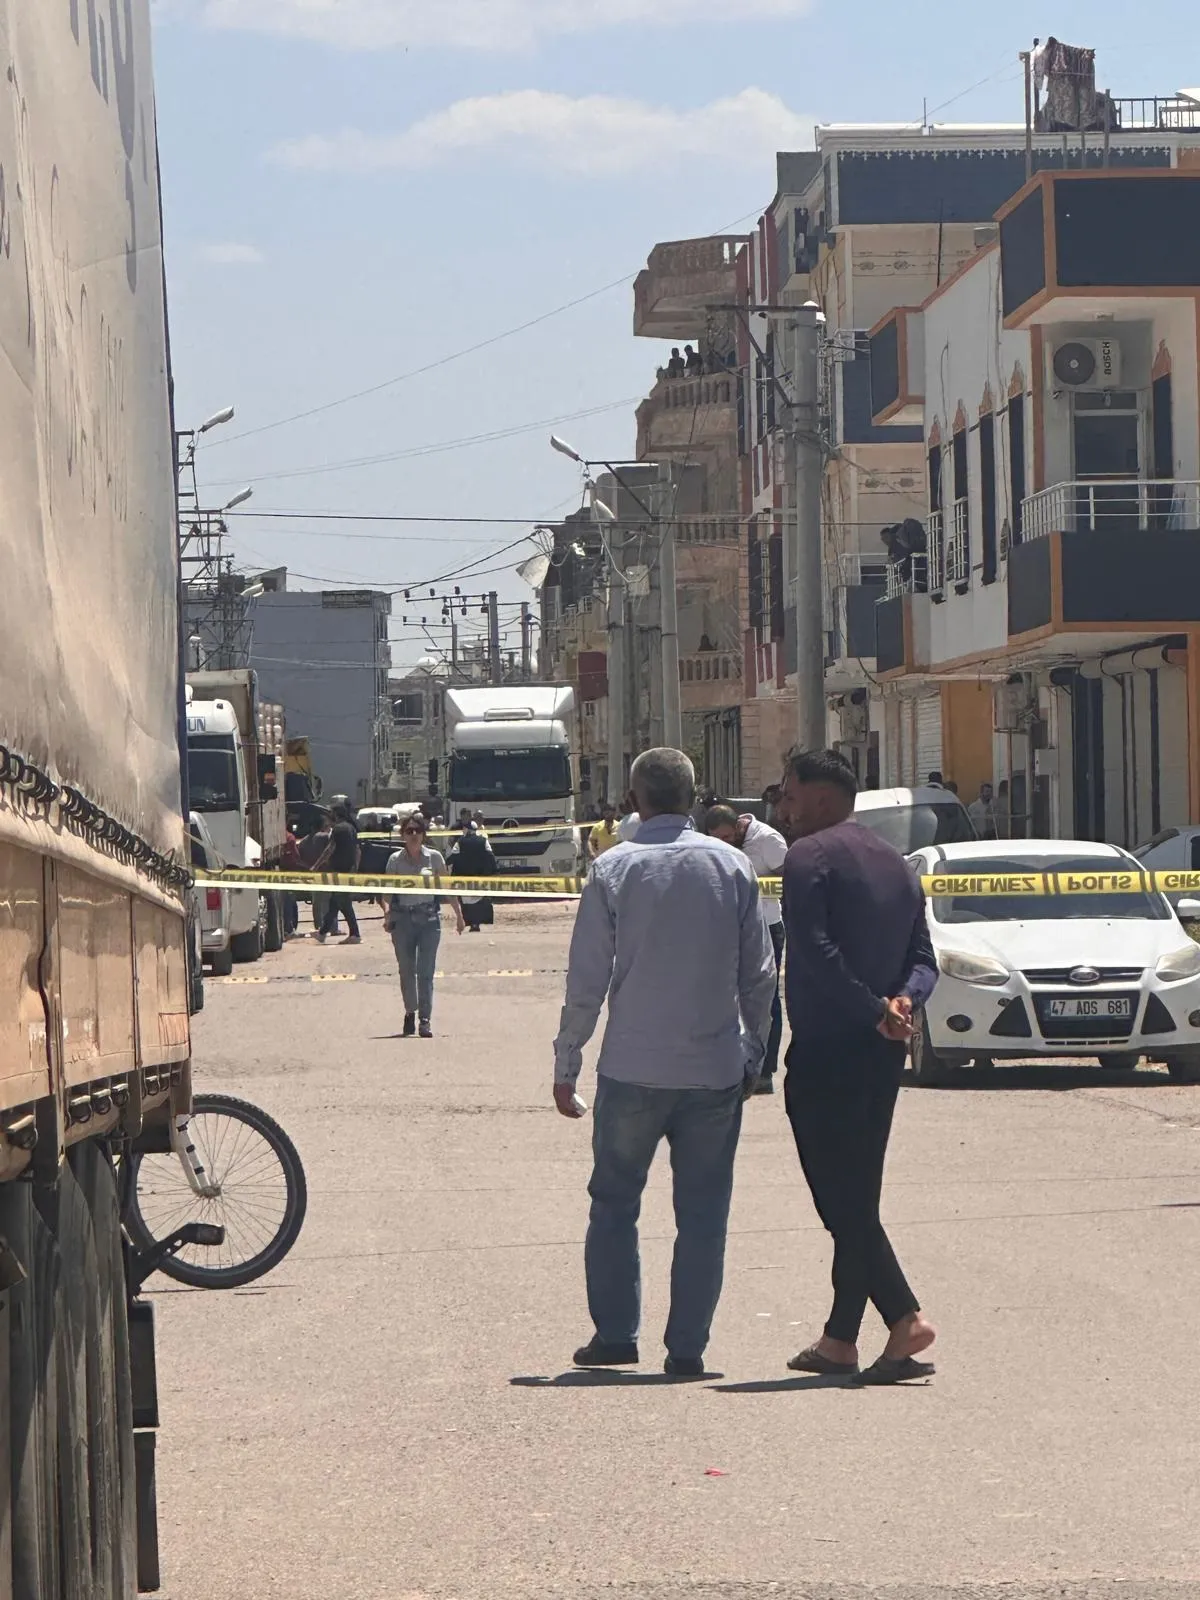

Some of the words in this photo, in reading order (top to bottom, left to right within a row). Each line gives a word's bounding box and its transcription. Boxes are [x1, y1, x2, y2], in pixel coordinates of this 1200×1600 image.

[1102, 341, 1112, 376] BOSCH
[1051, 1001, 1066, 1015] 47
[1076, 1001, 1098, 1015] ADS
[1108, 1000, 1128, 1014] 681
